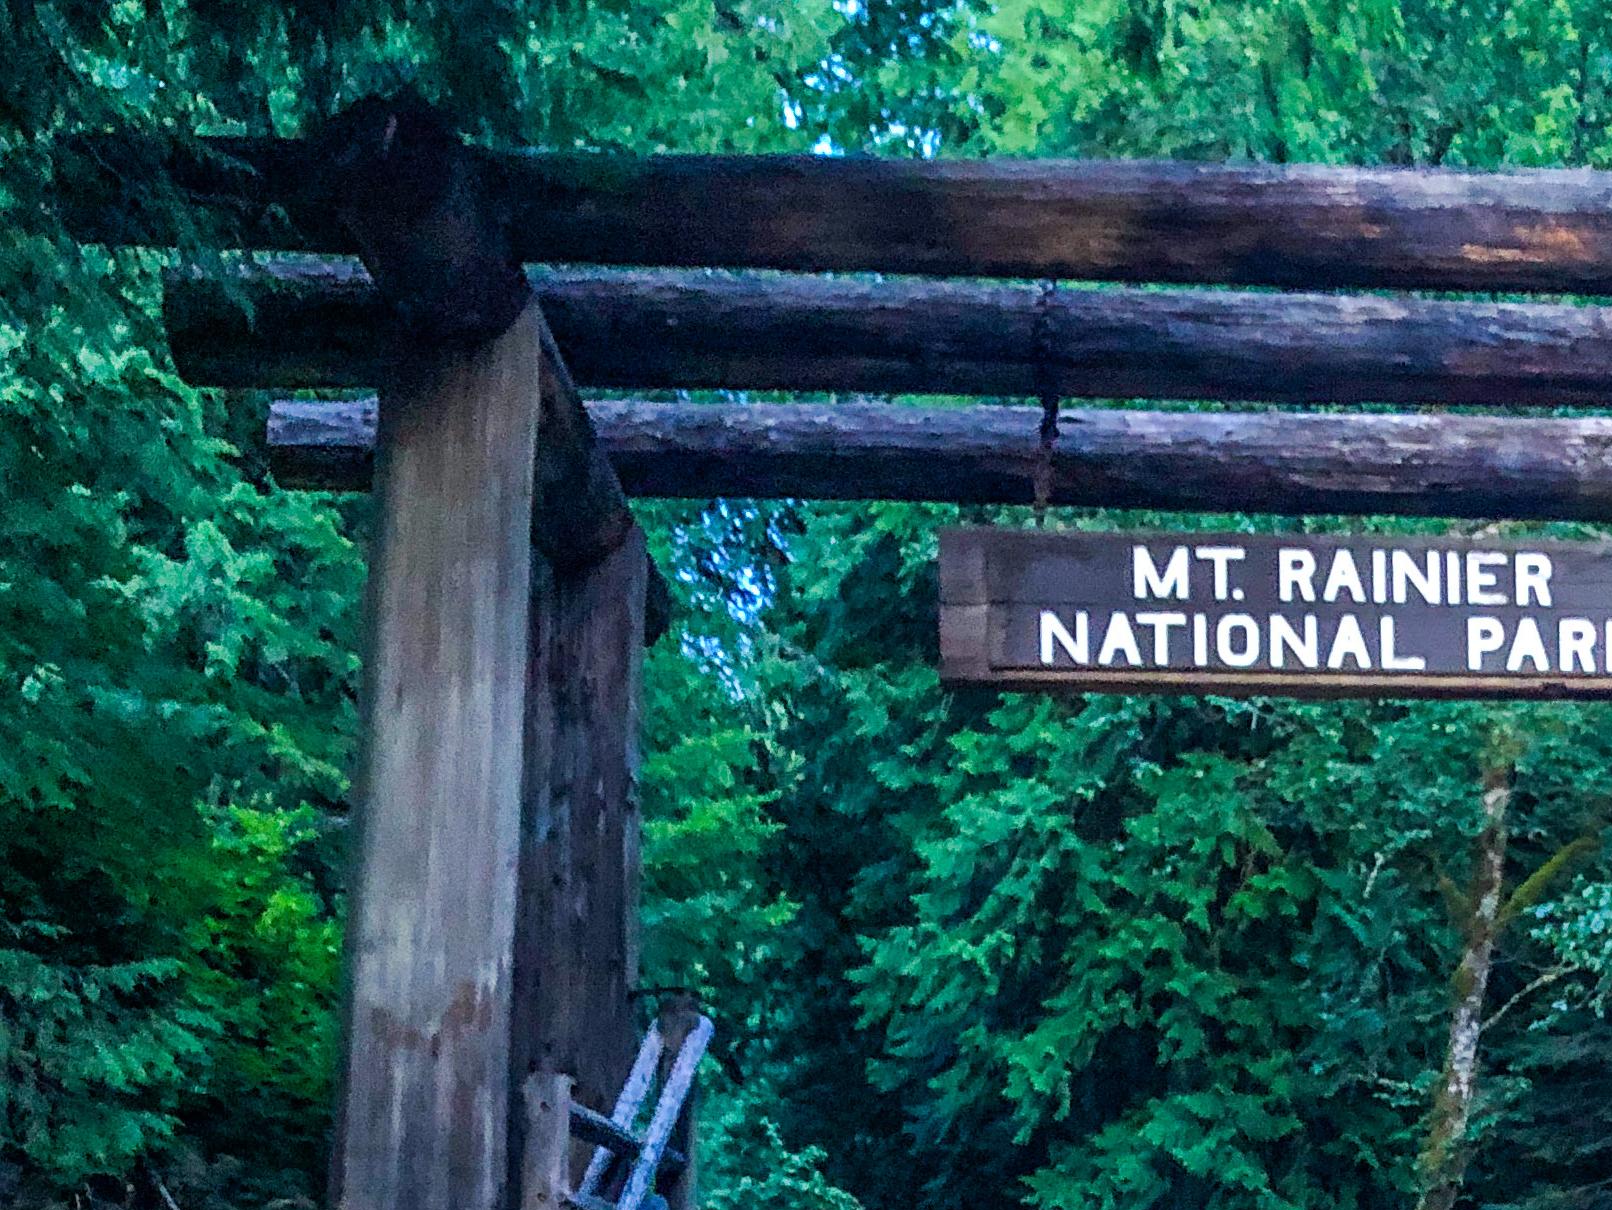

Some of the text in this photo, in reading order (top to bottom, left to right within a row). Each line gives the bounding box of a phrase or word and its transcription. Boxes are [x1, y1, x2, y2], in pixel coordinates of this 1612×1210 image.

[1133, 545, 1553, 607] MT. RAINIER
[1040, 611, 1426, 670] NATIONAL
